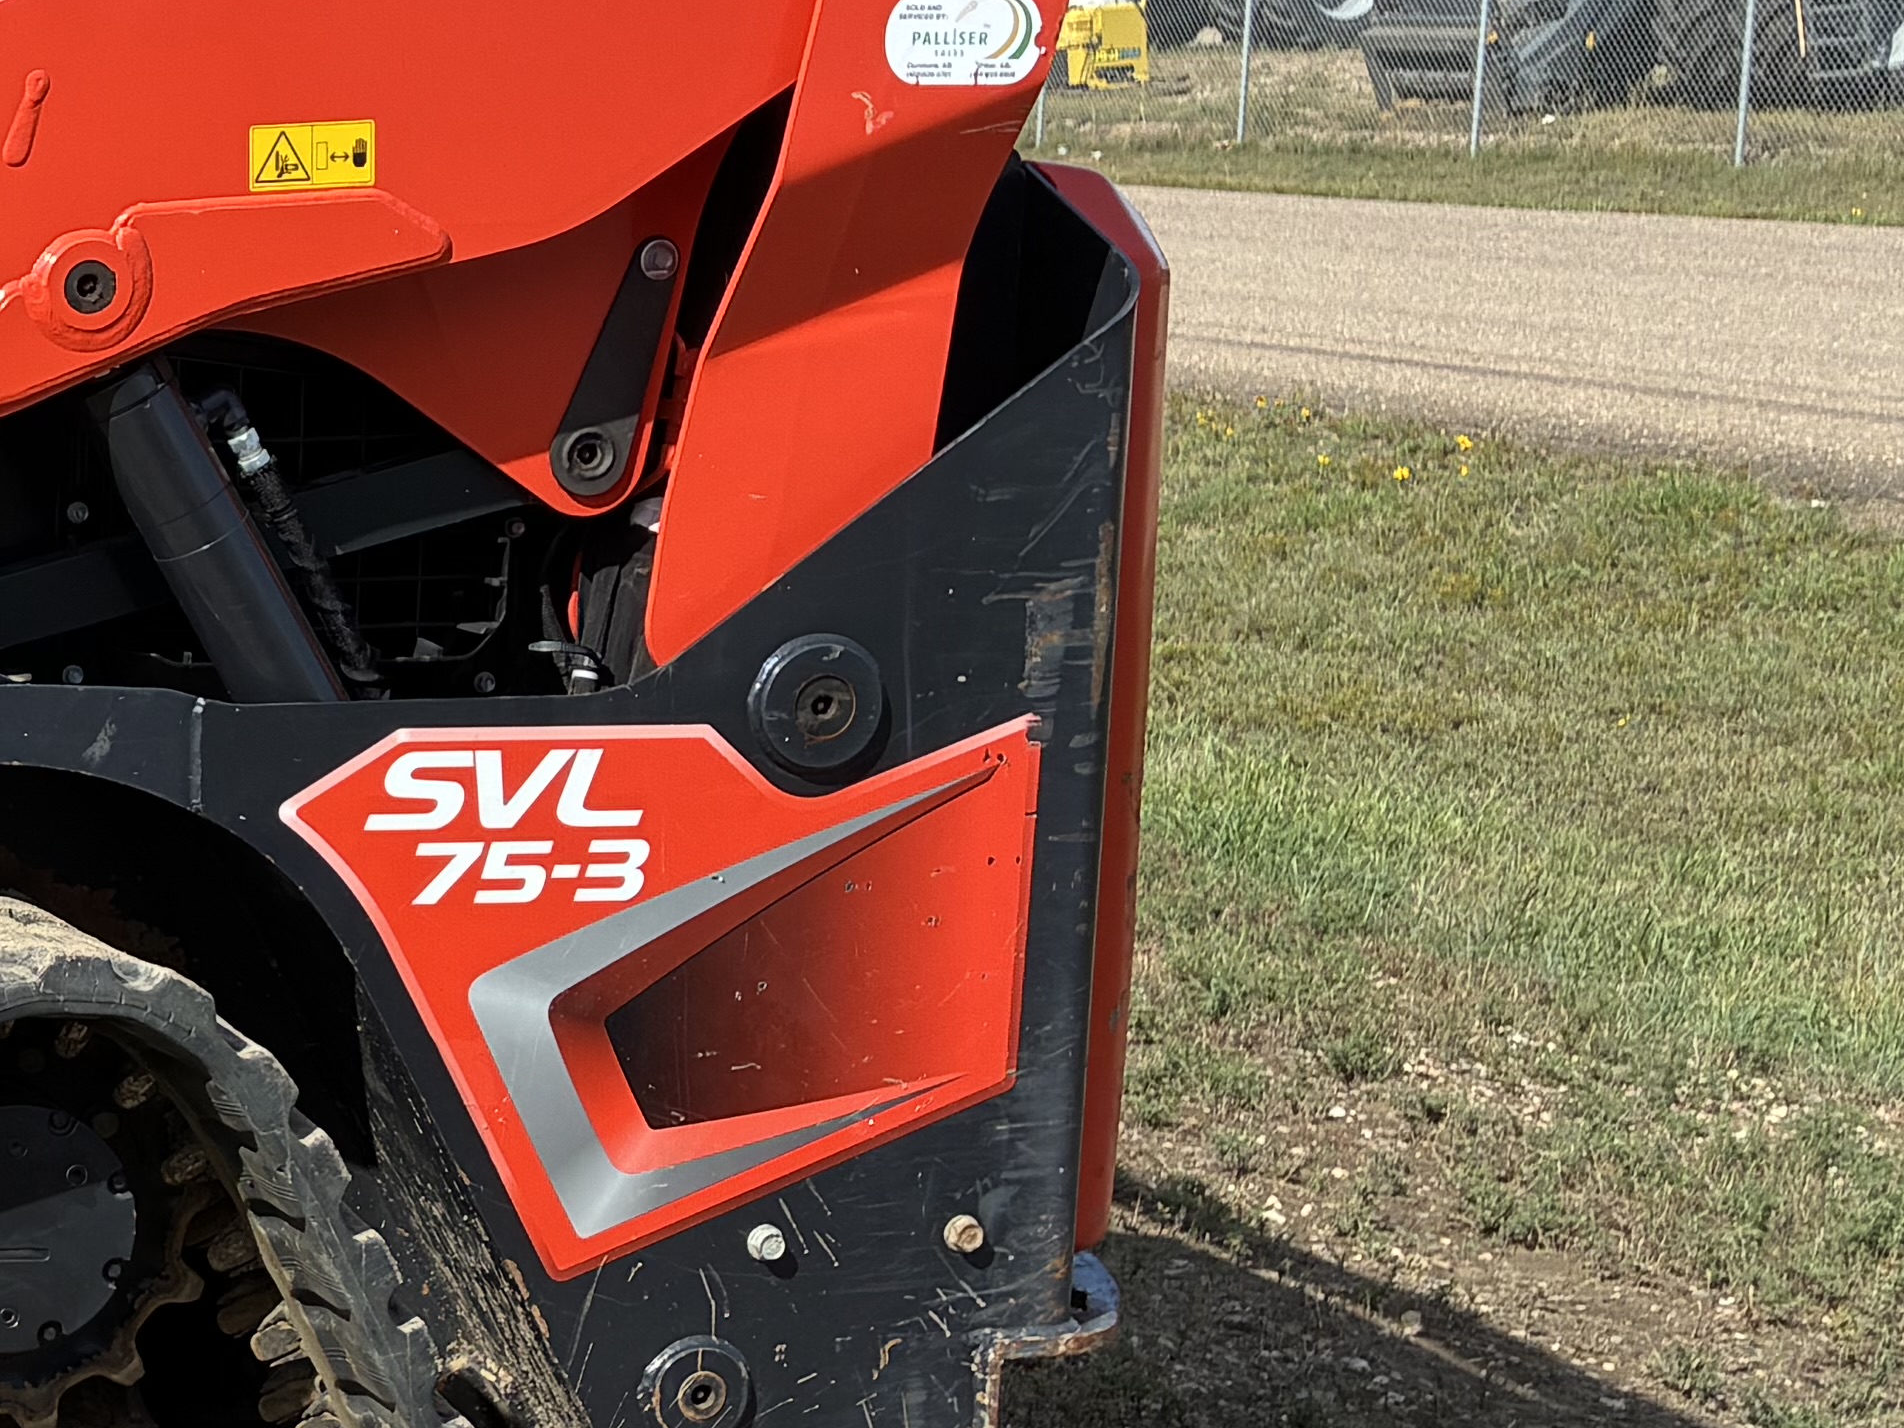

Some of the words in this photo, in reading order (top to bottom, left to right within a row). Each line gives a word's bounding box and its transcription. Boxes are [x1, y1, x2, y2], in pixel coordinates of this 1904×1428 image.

[912, 28, 988, 46] PALLISER
[364, 748, 644, 831] SVL
[412, 839, 650, 905] 75-3
